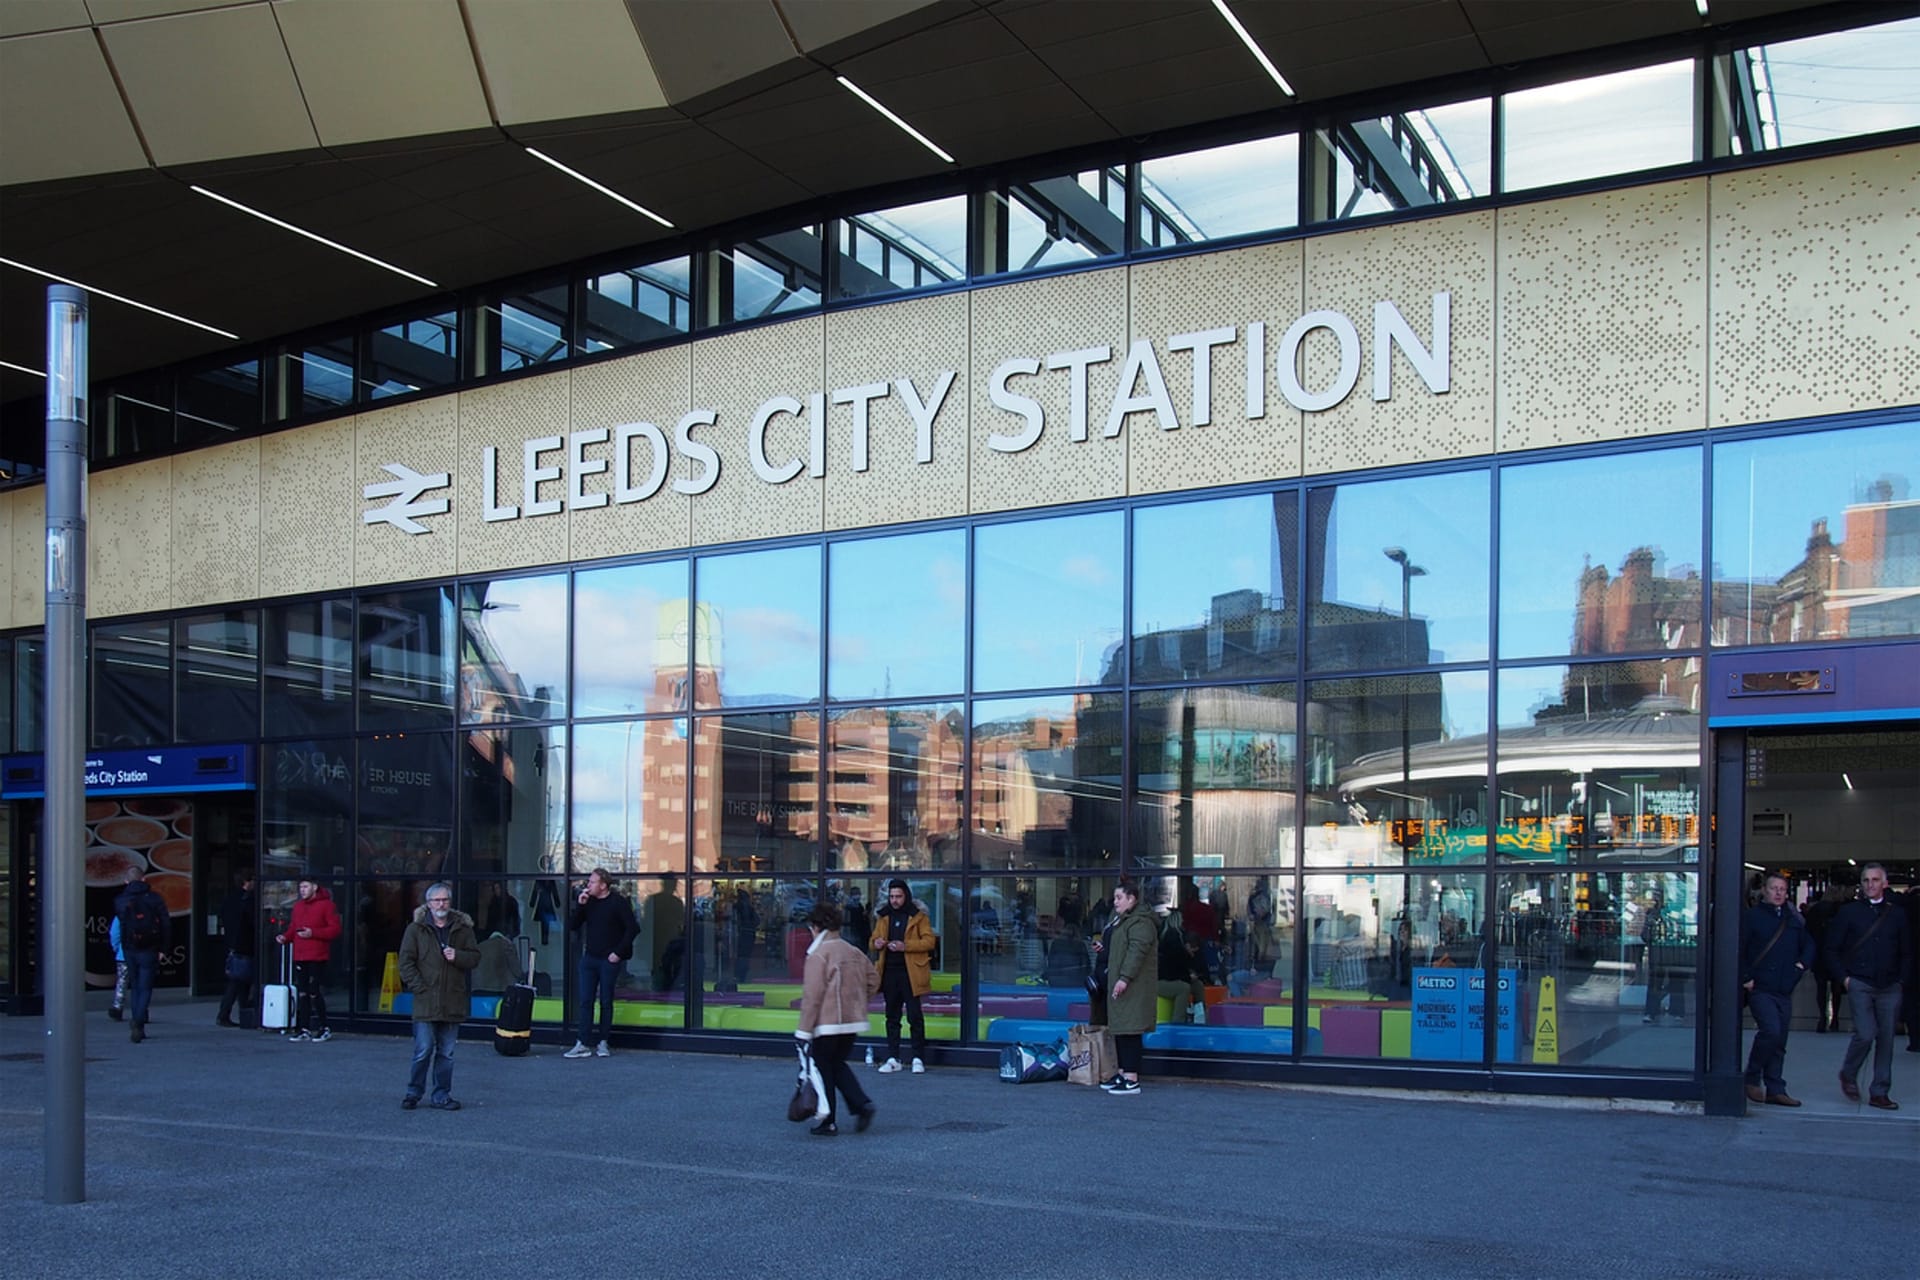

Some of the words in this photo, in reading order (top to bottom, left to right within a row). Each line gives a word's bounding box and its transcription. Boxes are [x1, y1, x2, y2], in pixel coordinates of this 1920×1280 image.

[483, 408, 721, 523] LEEDS
[748, 371, 958, 485] CITY
[987, 292, 1451, 453] STATION
[99, 771, 116, 786] City
[117, 769, 148, 783] Station
[321, 763, 345, 780] THE
[389, 768, 432, 787] HOUSE
[728, 800, 748, 816] THE
[1419, 978, 1456, 989] METRO
[1471, 978, 1509, 991] MEO
